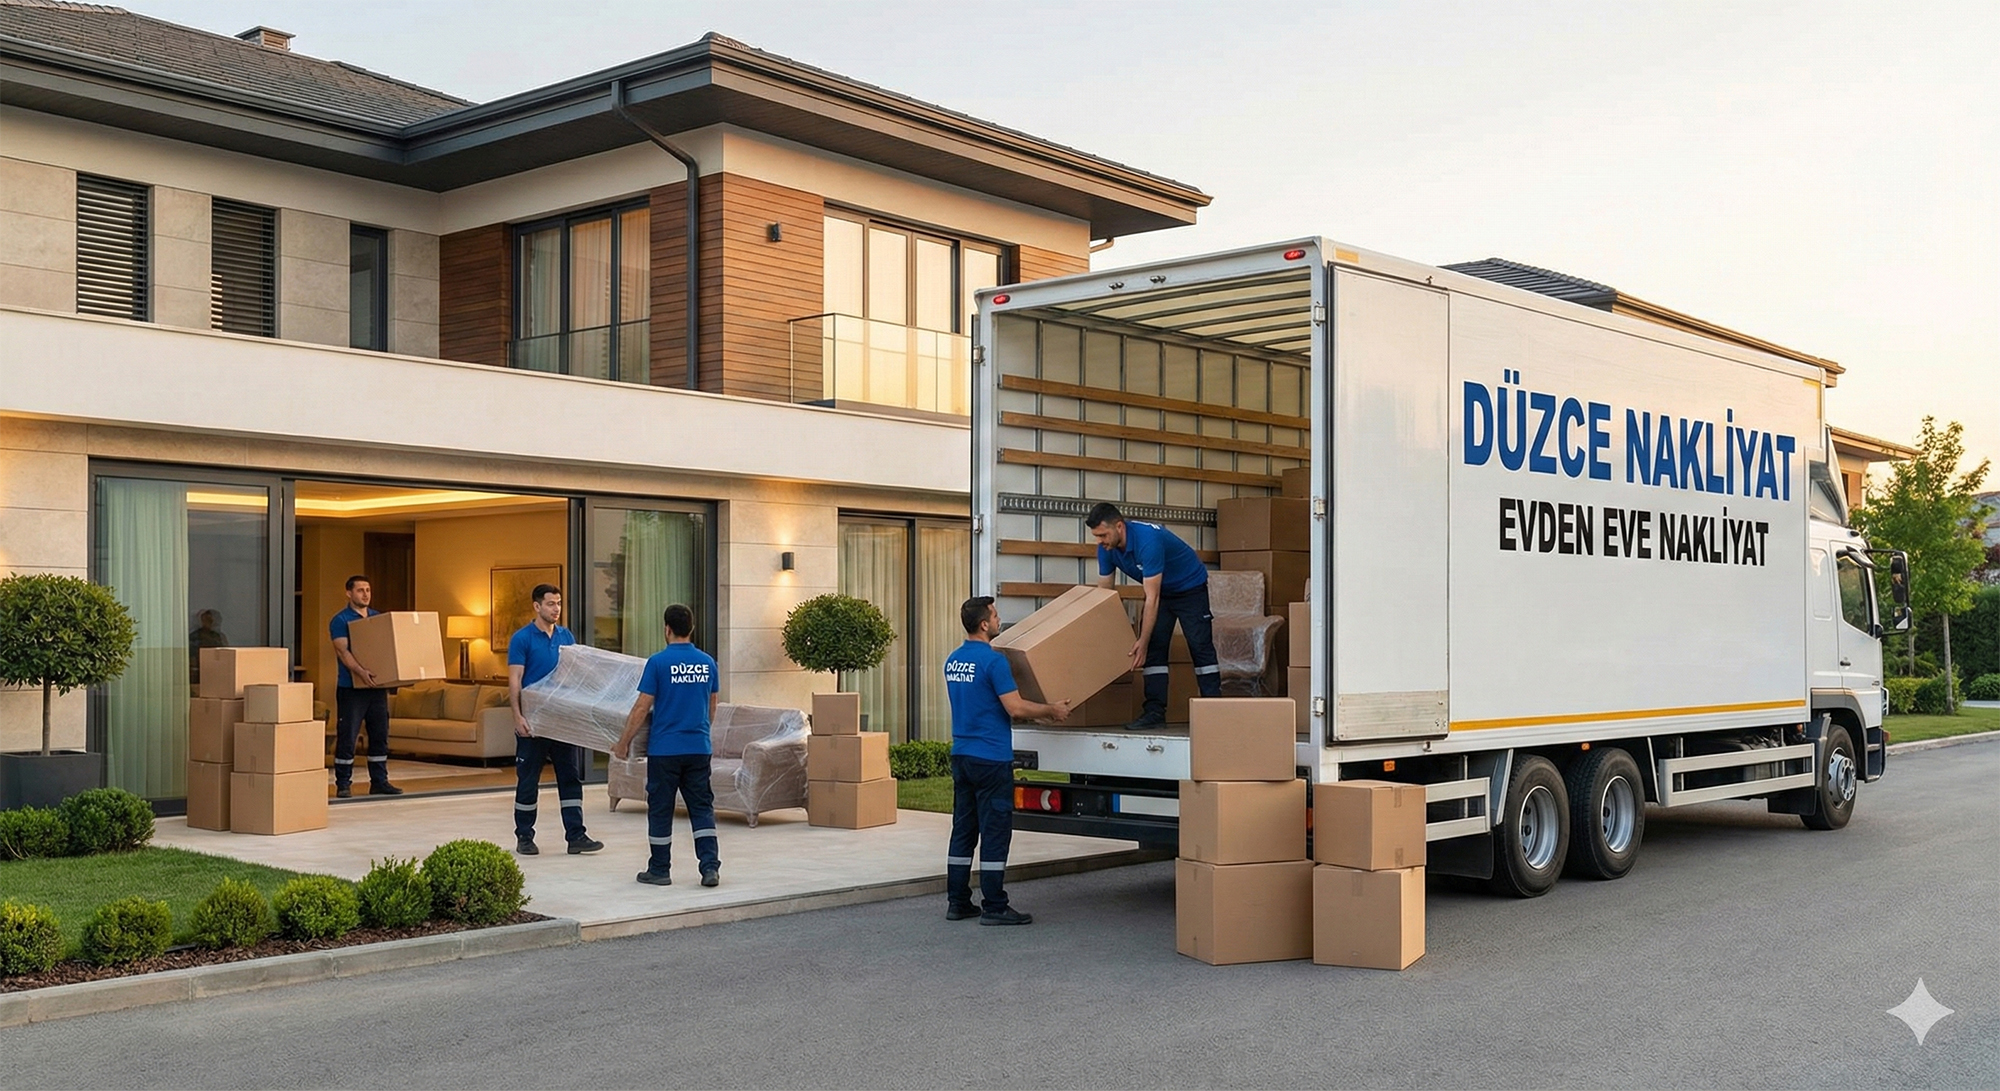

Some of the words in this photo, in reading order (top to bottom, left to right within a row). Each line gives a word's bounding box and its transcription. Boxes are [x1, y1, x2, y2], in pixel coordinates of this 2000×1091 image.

[1463, 369, 1612, 482] DÜZCE
[1625, 408, 1796, 501] NAKLİYAT
[1499, 498, 1594, 556] EVDEN
[1603, 507, 1652, 559] EVE
[1659, 506, 1769, 567] NAKLİYAT
